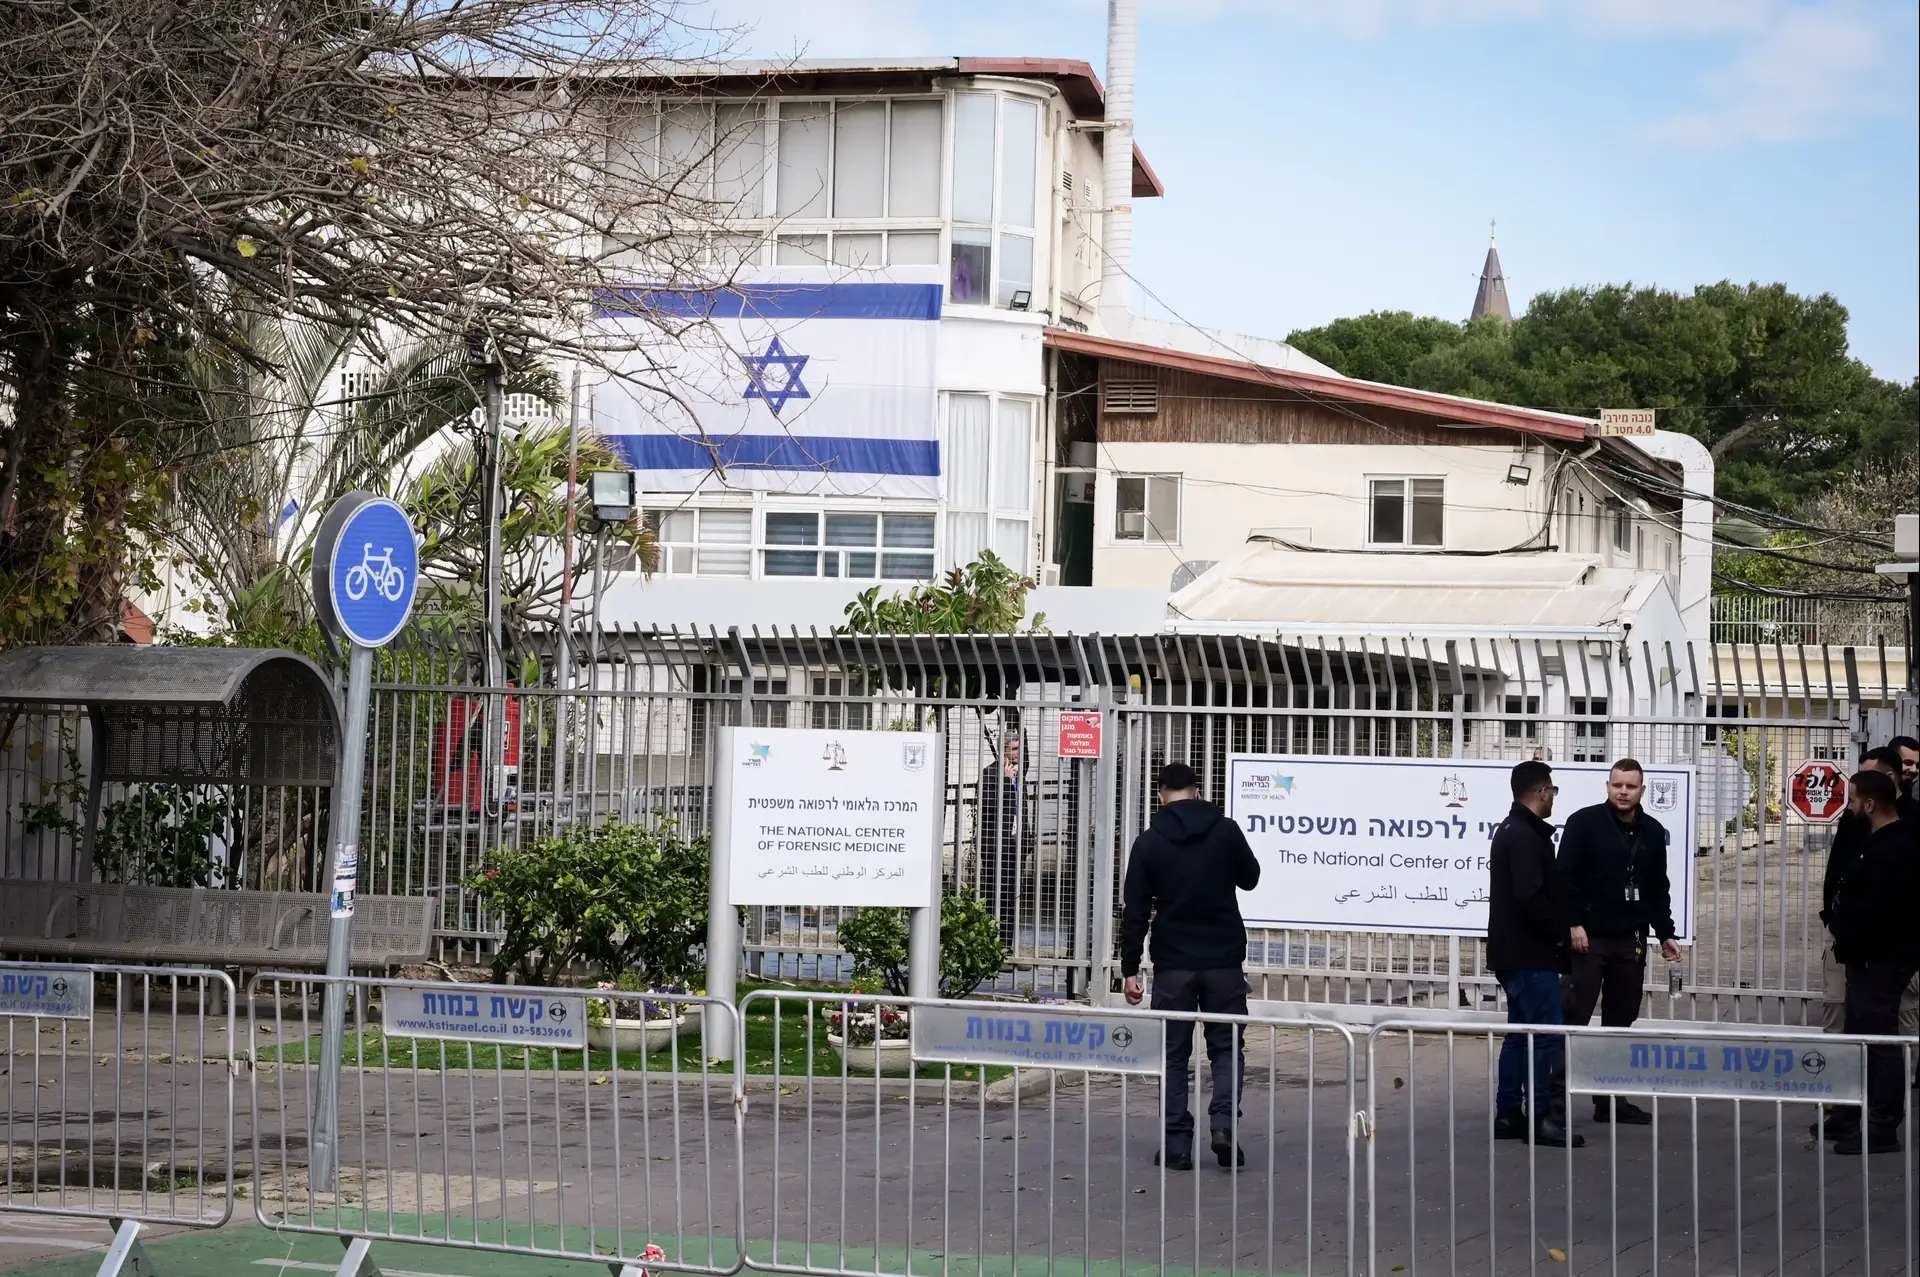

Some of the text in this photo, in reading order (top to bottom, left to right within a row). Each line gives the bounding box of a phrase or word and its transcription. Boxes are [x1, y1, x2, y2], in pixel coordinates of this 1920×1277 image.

[1604, 414, 1652, 423] גובה מירבי
[1614, 426, 1651, 434] 4.0 מטר
[748, 796, 918, 812] המרכז הלאומי לרפואה משפטית
[760, 826, 905, 838] THE NATIONAL CENTER
[1247, 815, 1356, 835] משפטית
[1369, 814, 1466, 839] לרפואה
[758, 840, 905, 853] OF FORENSIC MEDICINE
[1279, 850, 1307, 864] The
[1314, 851, 1384, 867] National
[1390, 854, 1448, 869] Center
[1454, 856, 1472, 870] of
[758, 865, 904, 880] المركز الوطني للطب الشرعي
[1335, 885, 1397, 904] الشرعي
[1405, 886, 1448, 904] للطب
[3, 975, 48, 999] קשת
[422, 993, 543, 1024] קשת במות
[397, 1020, 572, 1037] www.kstisrael.co.il 02-5839696
[966, 1016, 1106, 1050] קשת במות
[1629, 1043, 1794, 1077] קשת במות
[1593, 1075, 1742, 1089] www.kstisraelcoil
